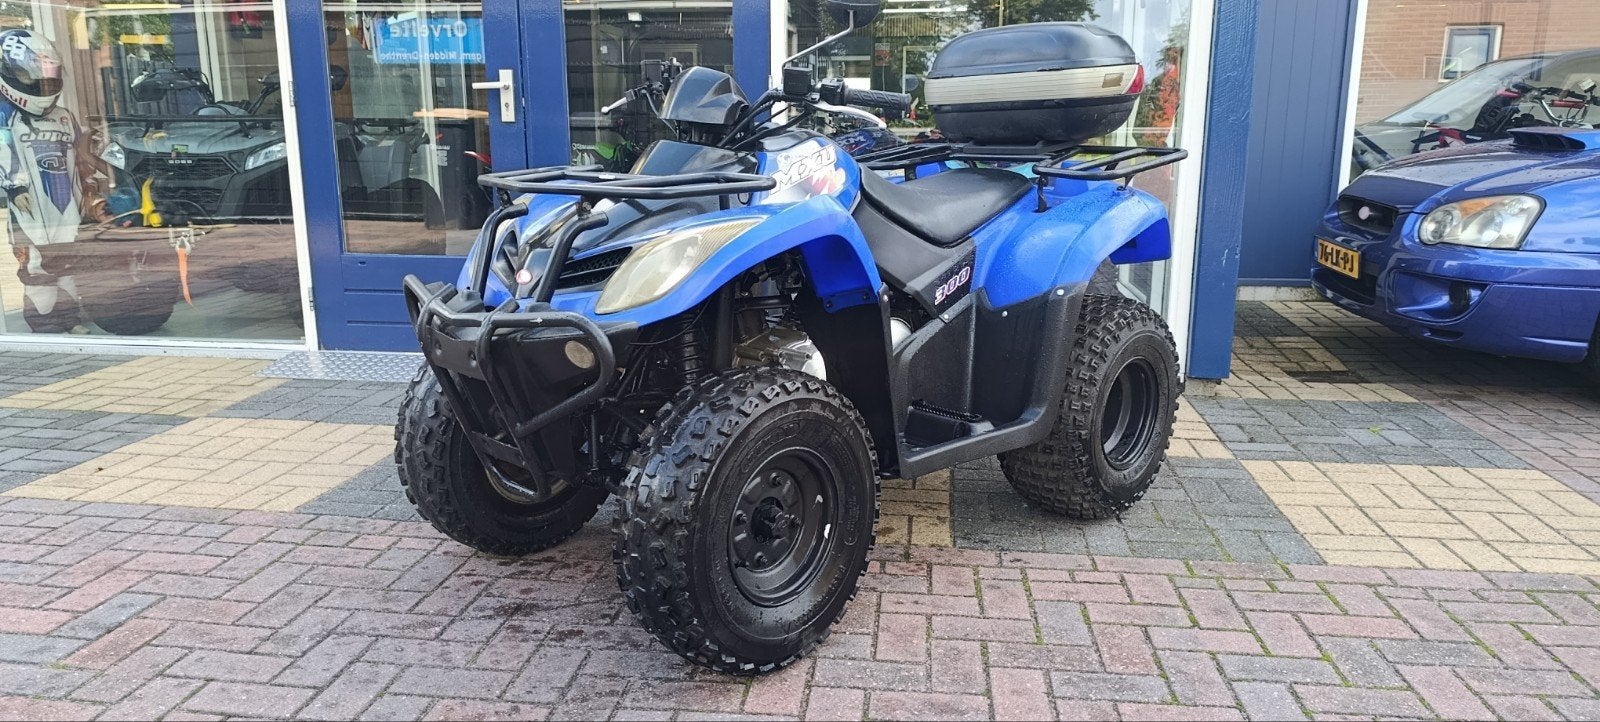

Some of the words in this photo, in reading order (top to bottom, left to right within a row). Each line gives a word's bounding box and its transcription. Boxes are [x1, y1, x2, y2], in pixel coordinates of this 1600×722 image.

[1, 84, 28, 108] Bull
[769, 144, 837, 196] MXU
[934, 266, 971, 306] 300
